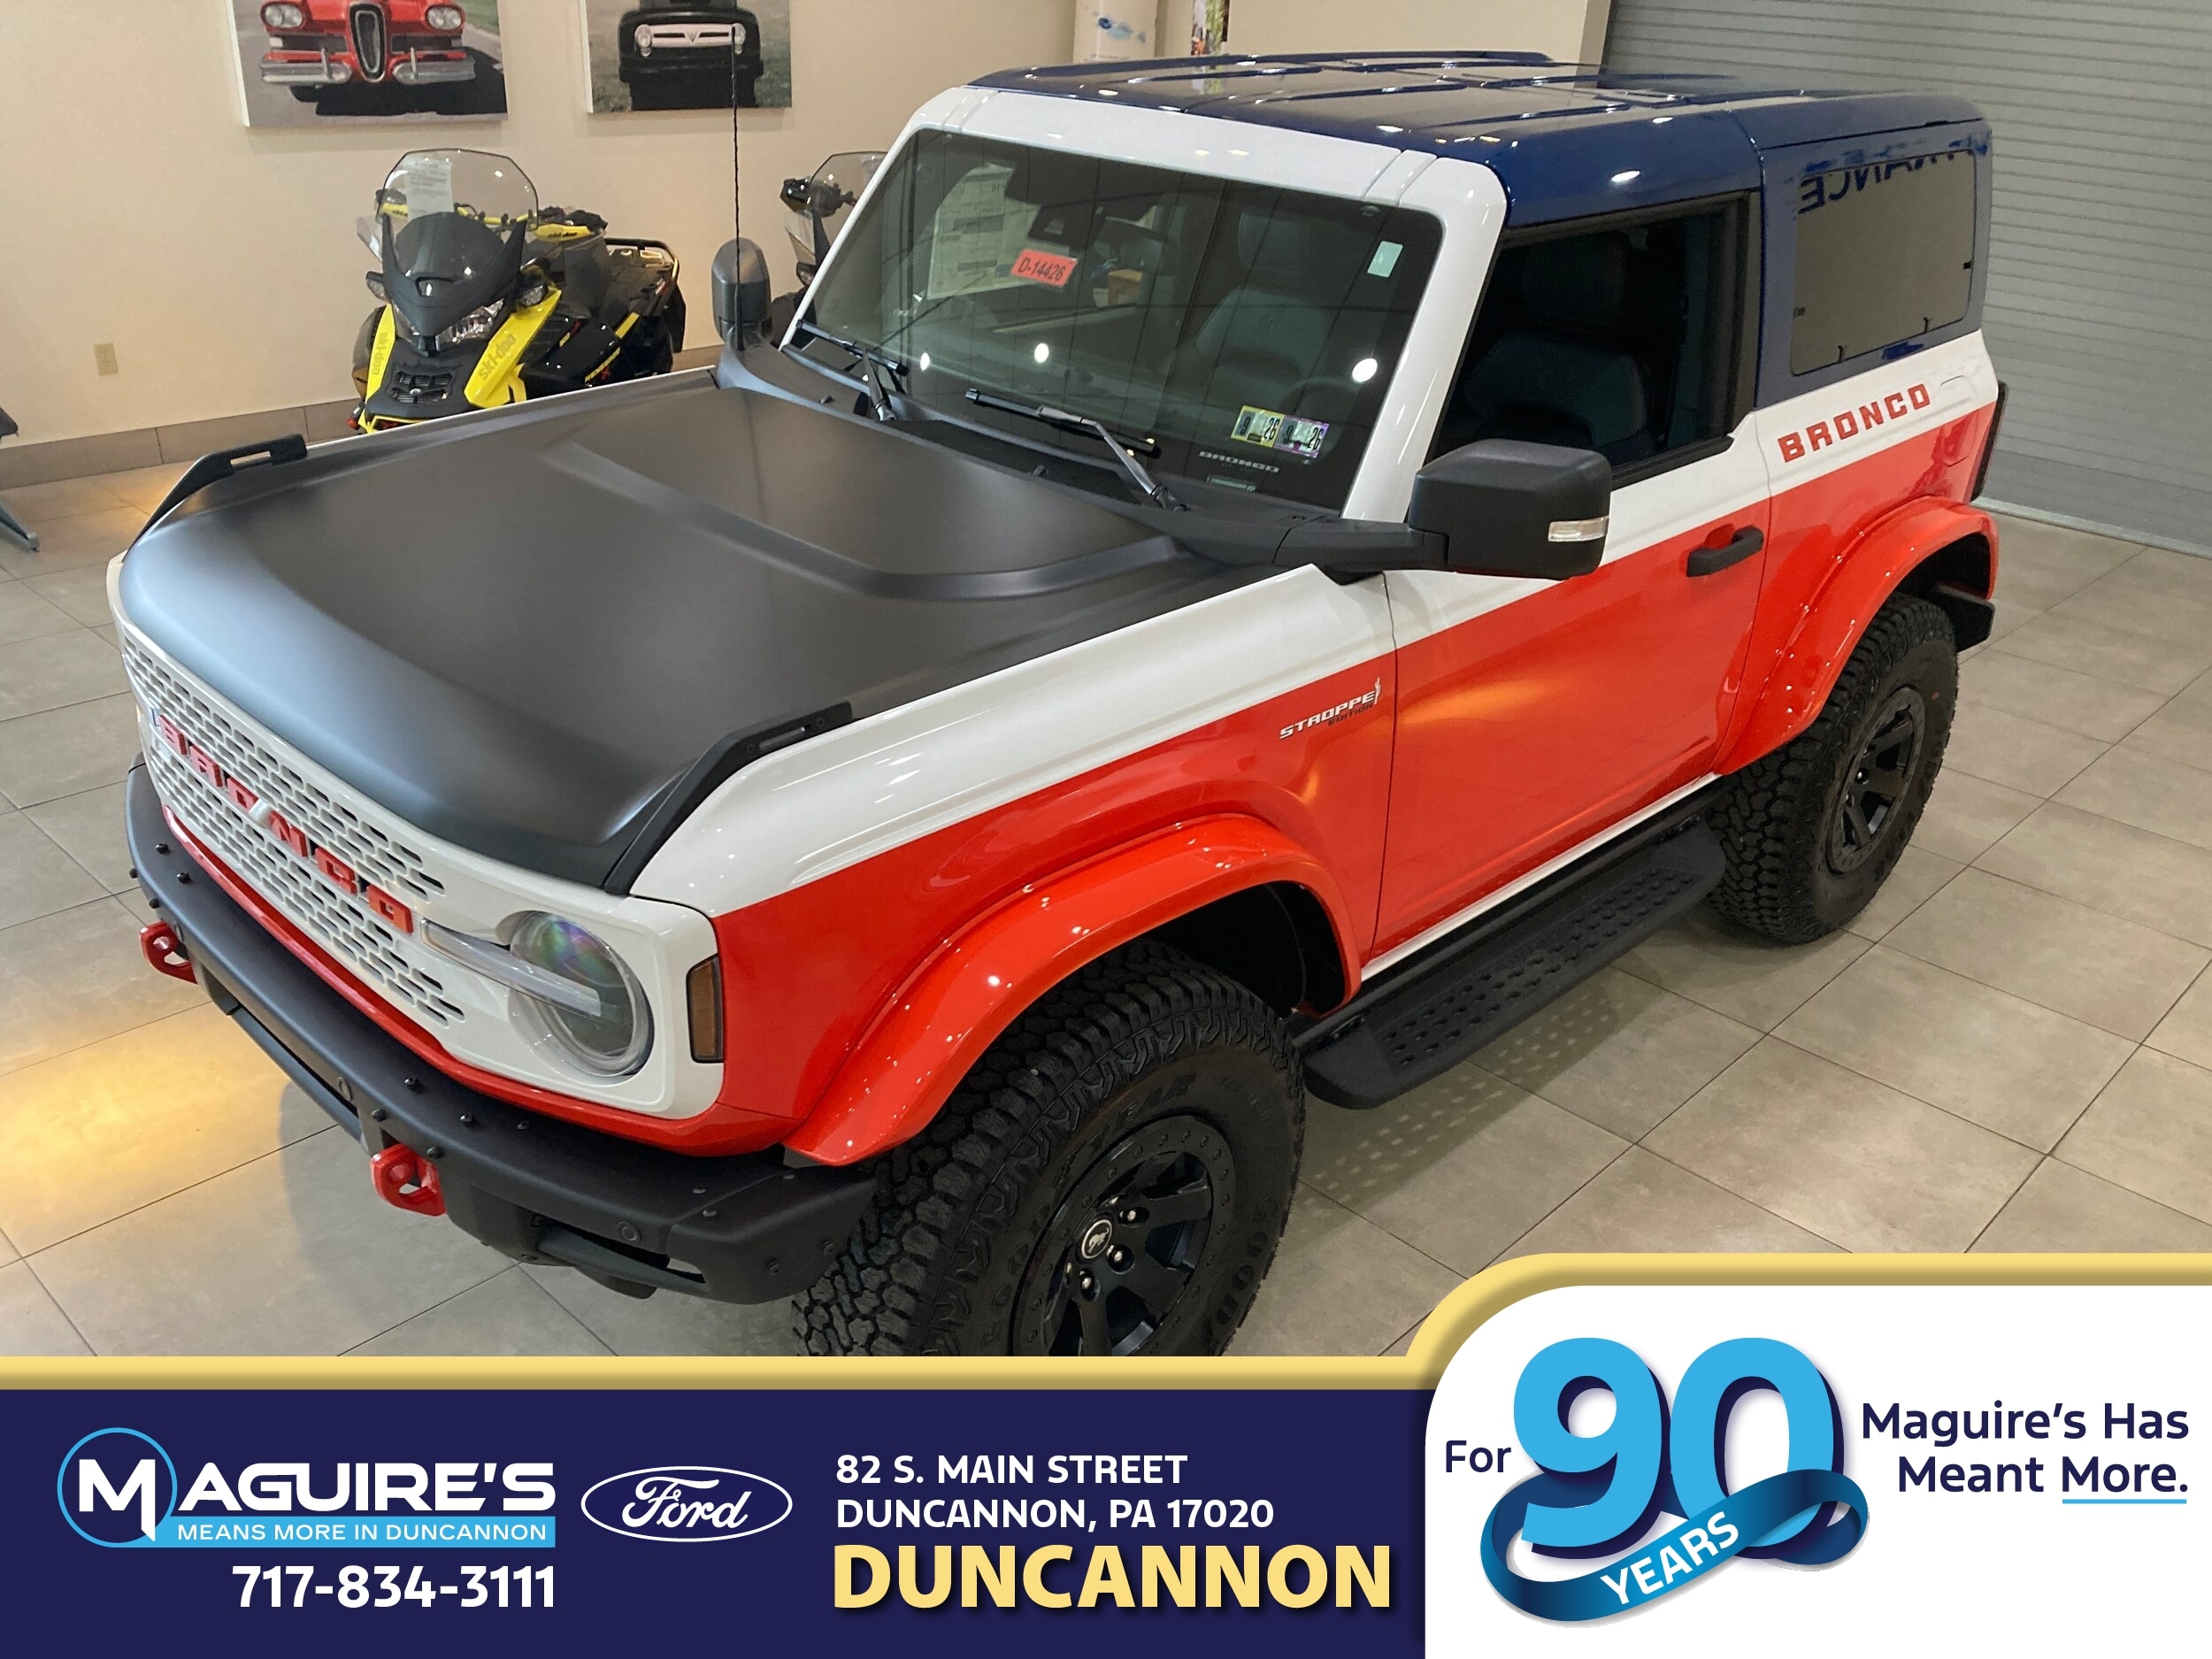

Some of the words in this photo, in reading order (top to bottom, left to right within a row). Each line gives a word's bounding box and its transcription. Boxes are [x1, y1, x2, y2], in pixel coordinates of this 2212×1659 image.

[1018, 257, 1066, 281] D-14426
[478, 333, 517, 380] ski-doo
[1263, 417, 1280, 441] 26
[1778, 383, 1931, 463] BRONCO
[1307, 426, 1325, 450] 26
[1199, 450, 1279, 473] BRONCO
[1279, 690, 1375, 740] STROPPE
[1328, 702, 1373, 726] EDITION
[157, 714, 414, 935] BRONCO
